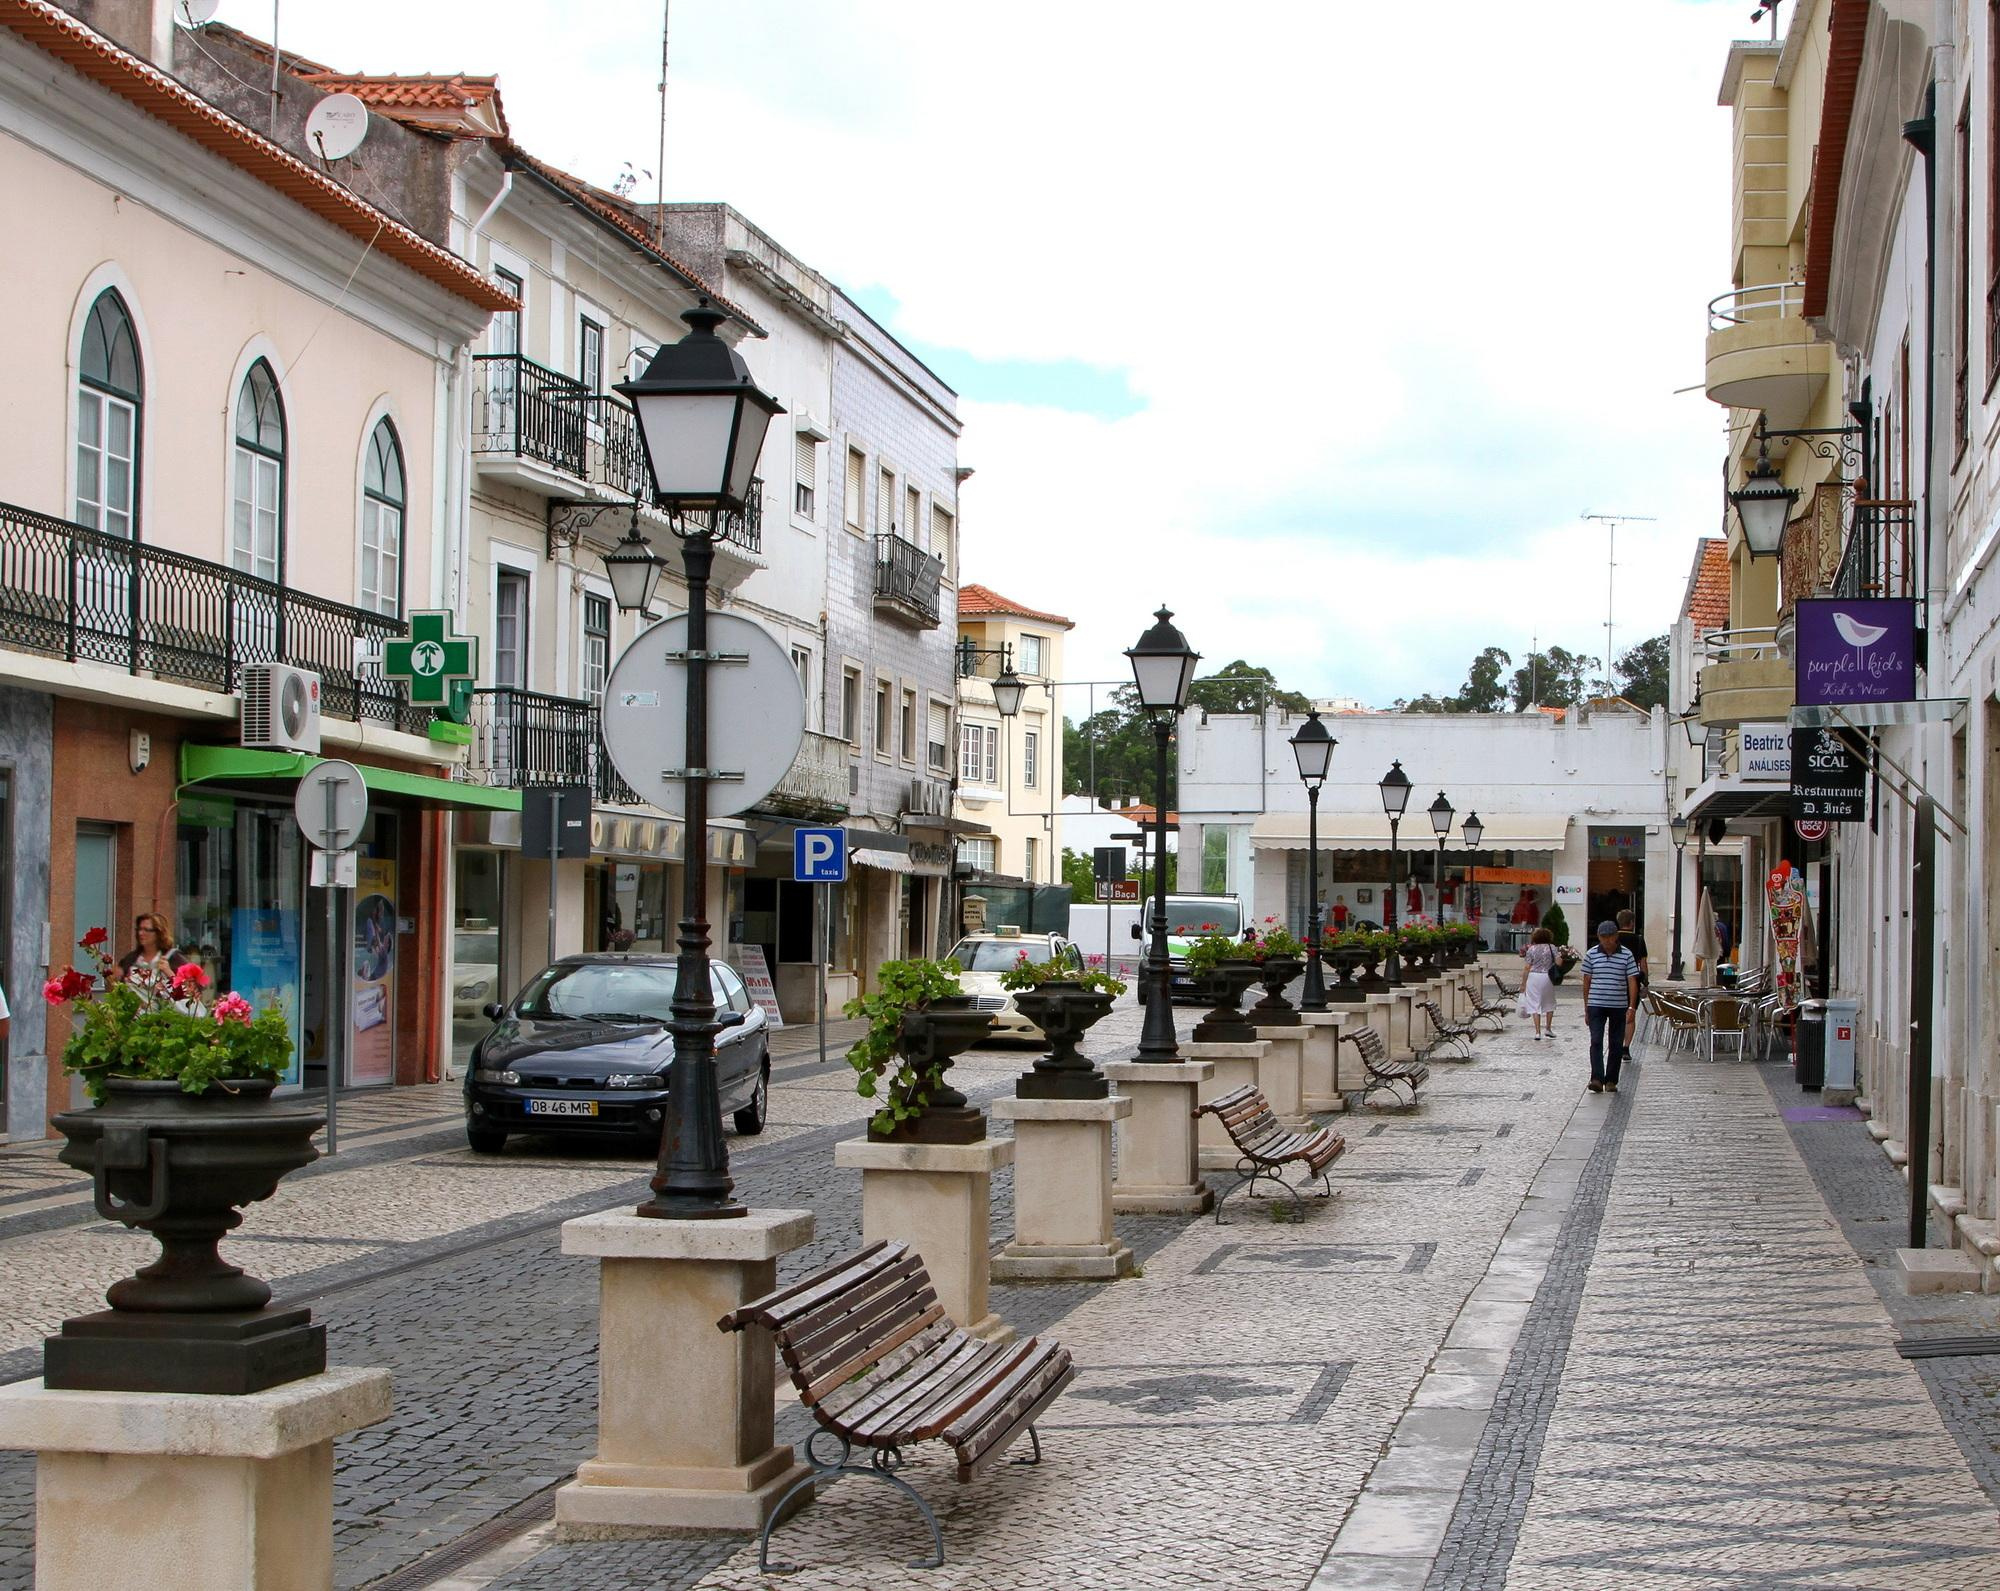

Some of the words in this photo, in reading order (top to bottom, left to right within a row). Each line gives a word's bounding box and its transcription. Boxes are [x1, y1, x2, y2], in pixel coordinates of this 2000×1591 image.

[1807, 653, 1855, 680] purple
[1868, 651, 1903, 679] kids
[1858, 682, 1888, 695] Wear
[1744, 734, 1783, 750] Beatriz
[1749, 757, 1791, 771] ANÁLISES
[1808, 755, 1849, 768] SICAL
[1792, 784, 1864, 797] Restaurante
[1803, 802, 1819, 814] D.
[1823, 801, 1852, 815] Inês
[804, 834, 835, 876] P
[1114, 891, 1136, 900] Baça
